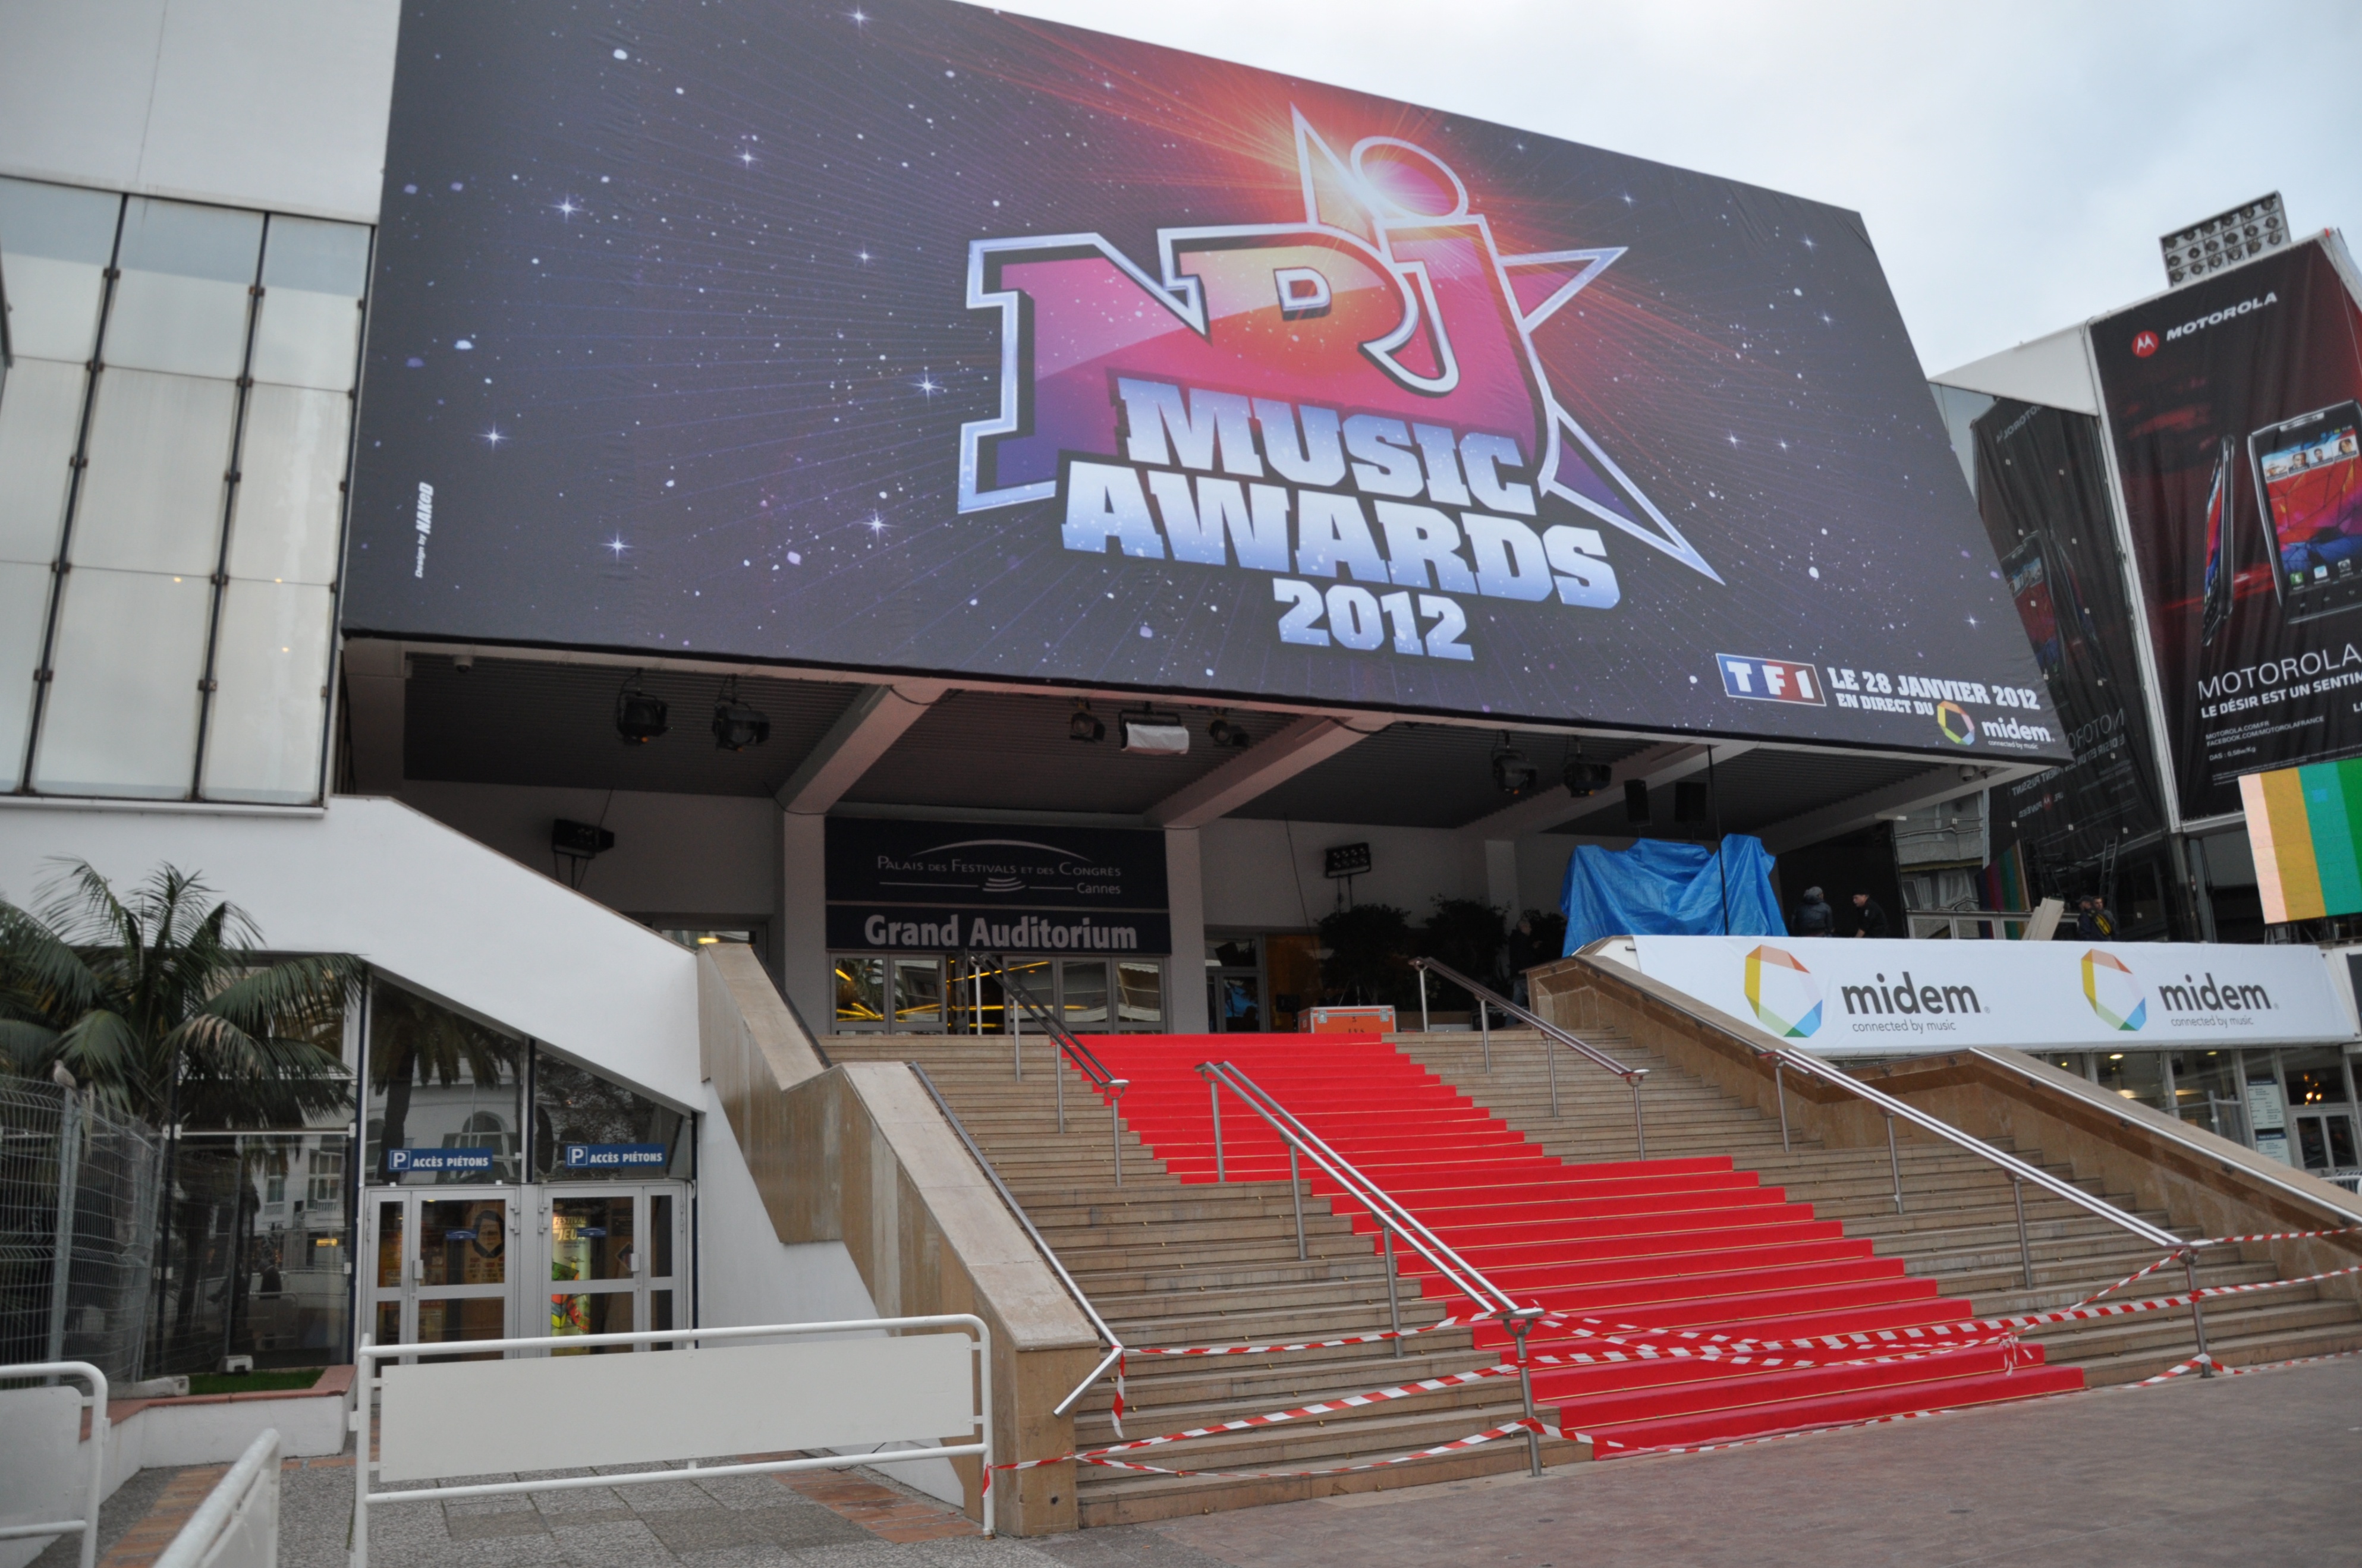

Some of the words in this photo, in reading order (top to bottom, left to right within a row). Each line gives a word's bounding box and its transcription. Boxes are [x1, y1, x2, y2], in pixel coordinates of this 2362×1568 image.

[2166, 292, 2277, 342] MOTOROLA
[1116, 376, 1537, 517] MUSIC
[418, 534, 427, 545] by
[1061, 460, 1621, 610] AWARDS
[1272, 578, 1474, 661] 2012
[1726, 661, 1814, 698] TF1
[2198, 643, 2362, 700] MOTOROLA
[1827, 667, 1859, 691] LE
[1863, 671, 1892, 694] 28
[1898, 675, 1987, 704] JANVIER
[1992, 685, 2040, 710] 2012
[2201, 704, 2218, 718] LE
[2220, 696, 2259, 714] DÉSIR
[2262, 689, 2286, 705] EST
[2289, 684, 2310, 698] UN
[1836, 693, 1859, 709] EN
[1860, 695, 1911, 713] DIRECT
[1916, 699, 1935, 716] DU
[1982, 717, 2051, 742] midem
[2206, 720, 2270, 741] MOTOROLA.COM/FR
[2206, 716, 2325, 747] FACEBOOK.COM/MOTOROLAFRANCE
[2209, 752, 2223, 761] DAS
[1077, 882, 1121, 894] Cannes
[865, 915, 959, 946] Grand
[969, 917, 1137, 949] Auditorium
[1841, 971, 1981, 1014] midem
[2158, 972, 2272, 1010] midem
[1853, 1019, 1908, 1032] connected
[1910, 1019, 1924, 1034] by
[1927, 1019, 1957, 1031] music
[2171, 1016, 2216, 1027] connected
[2217, 1016, 2228, 1028] by
[2230, 1015, 2254, 1025] music
[393, 1152, 407, 1167] P
[413, 1154, 443, 1167] ACCÈS
[446, 1153, 489, 1167] PIÉTONS
[571, 1150, 584, 1164] P
[590, 1151, 619, 1163] ACCÈS
[622, 1148, 662, 1163] PIÉTONS
[553, 1216, 587, 1224] FESTIVAL
